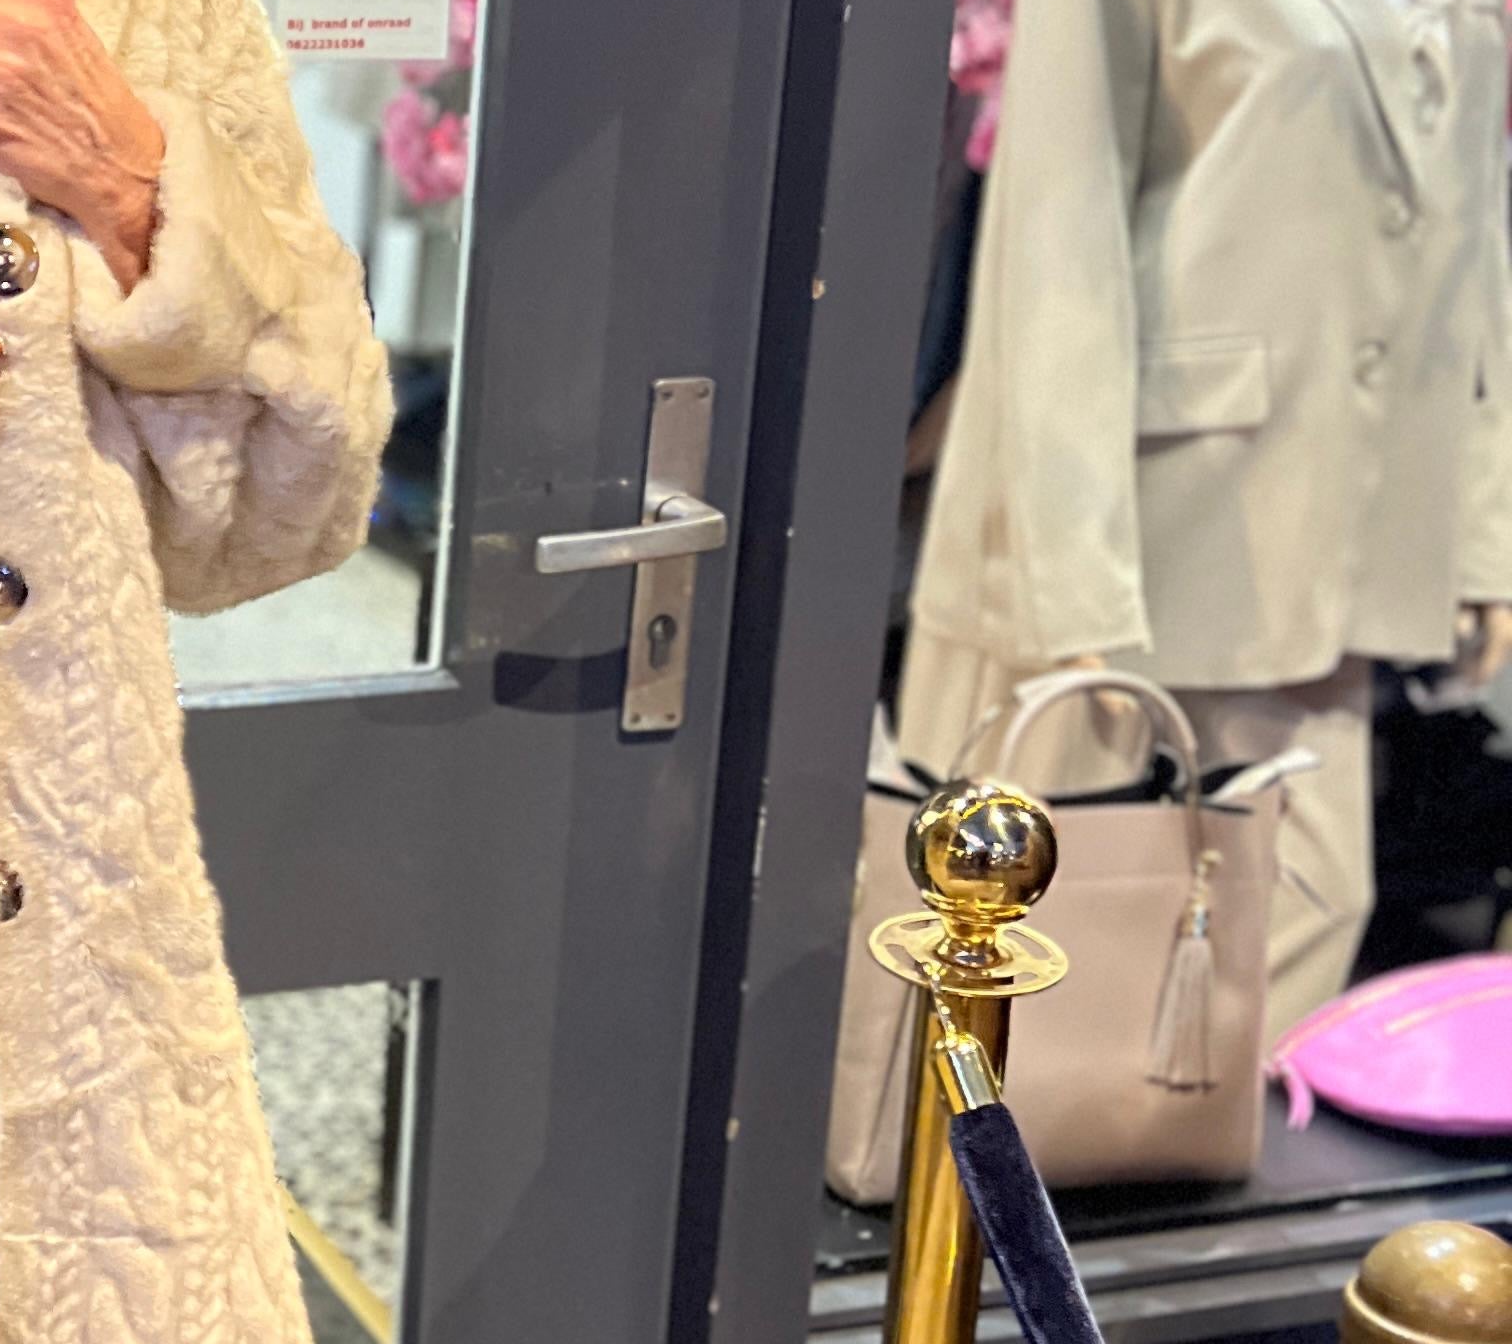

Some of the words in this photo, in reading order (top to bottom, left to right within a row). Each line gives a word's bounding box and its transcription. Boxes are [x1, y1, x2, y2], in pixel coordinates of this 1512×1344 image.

[287, 19, 304, 32] Bij
[311, 18, 349, 30] brand
[351, 18, 365, 29] of
